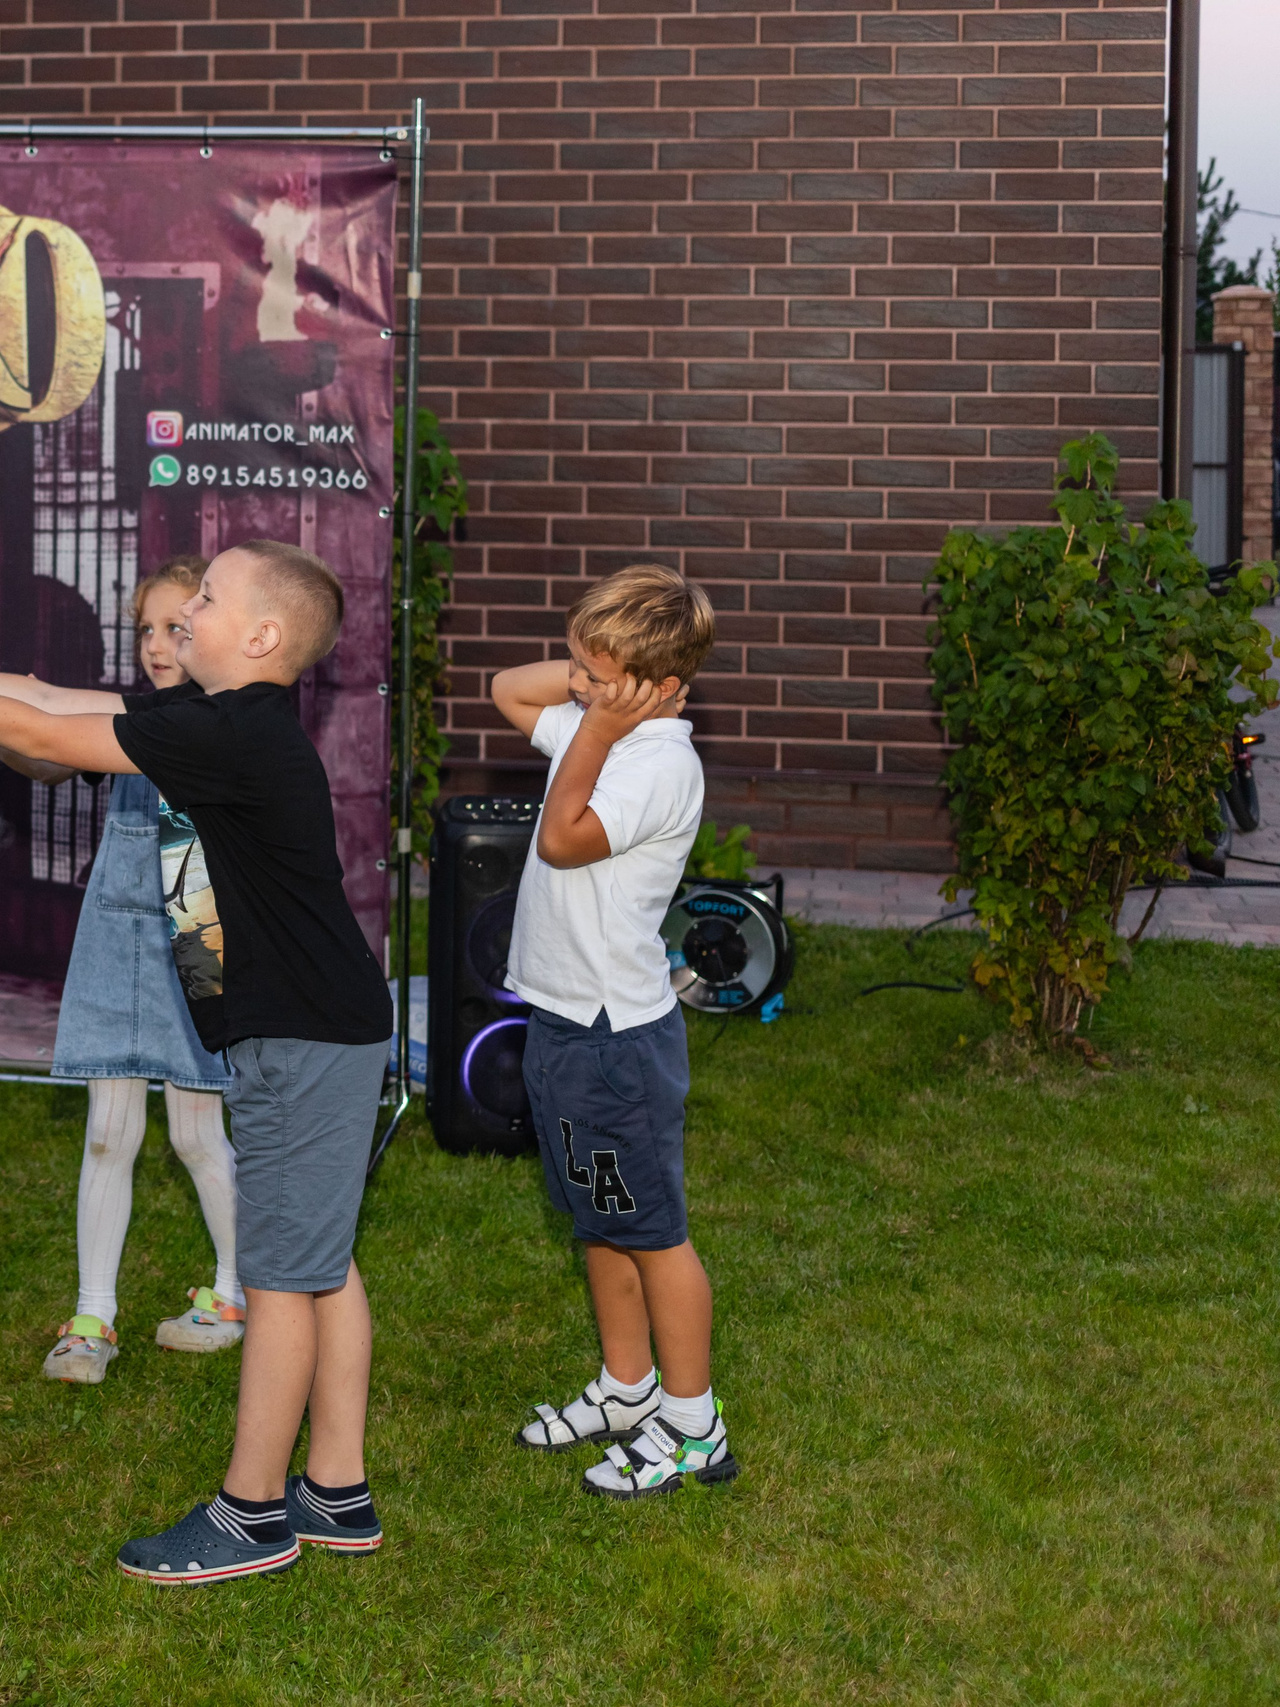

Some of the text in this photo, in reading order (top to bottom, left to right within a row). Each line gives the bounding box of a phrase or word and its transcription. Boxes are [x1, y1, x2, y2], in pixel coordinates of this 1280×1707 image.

[185, 422, 355, 446] ANIMATOR_MAX
[186, 464, 368, 489] 89154519366
[687, 900, 745, 917] TOPFORT
[573, 1117, 590, 1129] LOS
[559, 1117, 637, 1215] LA
[651, 1426, 674, 1450] MUTONG
